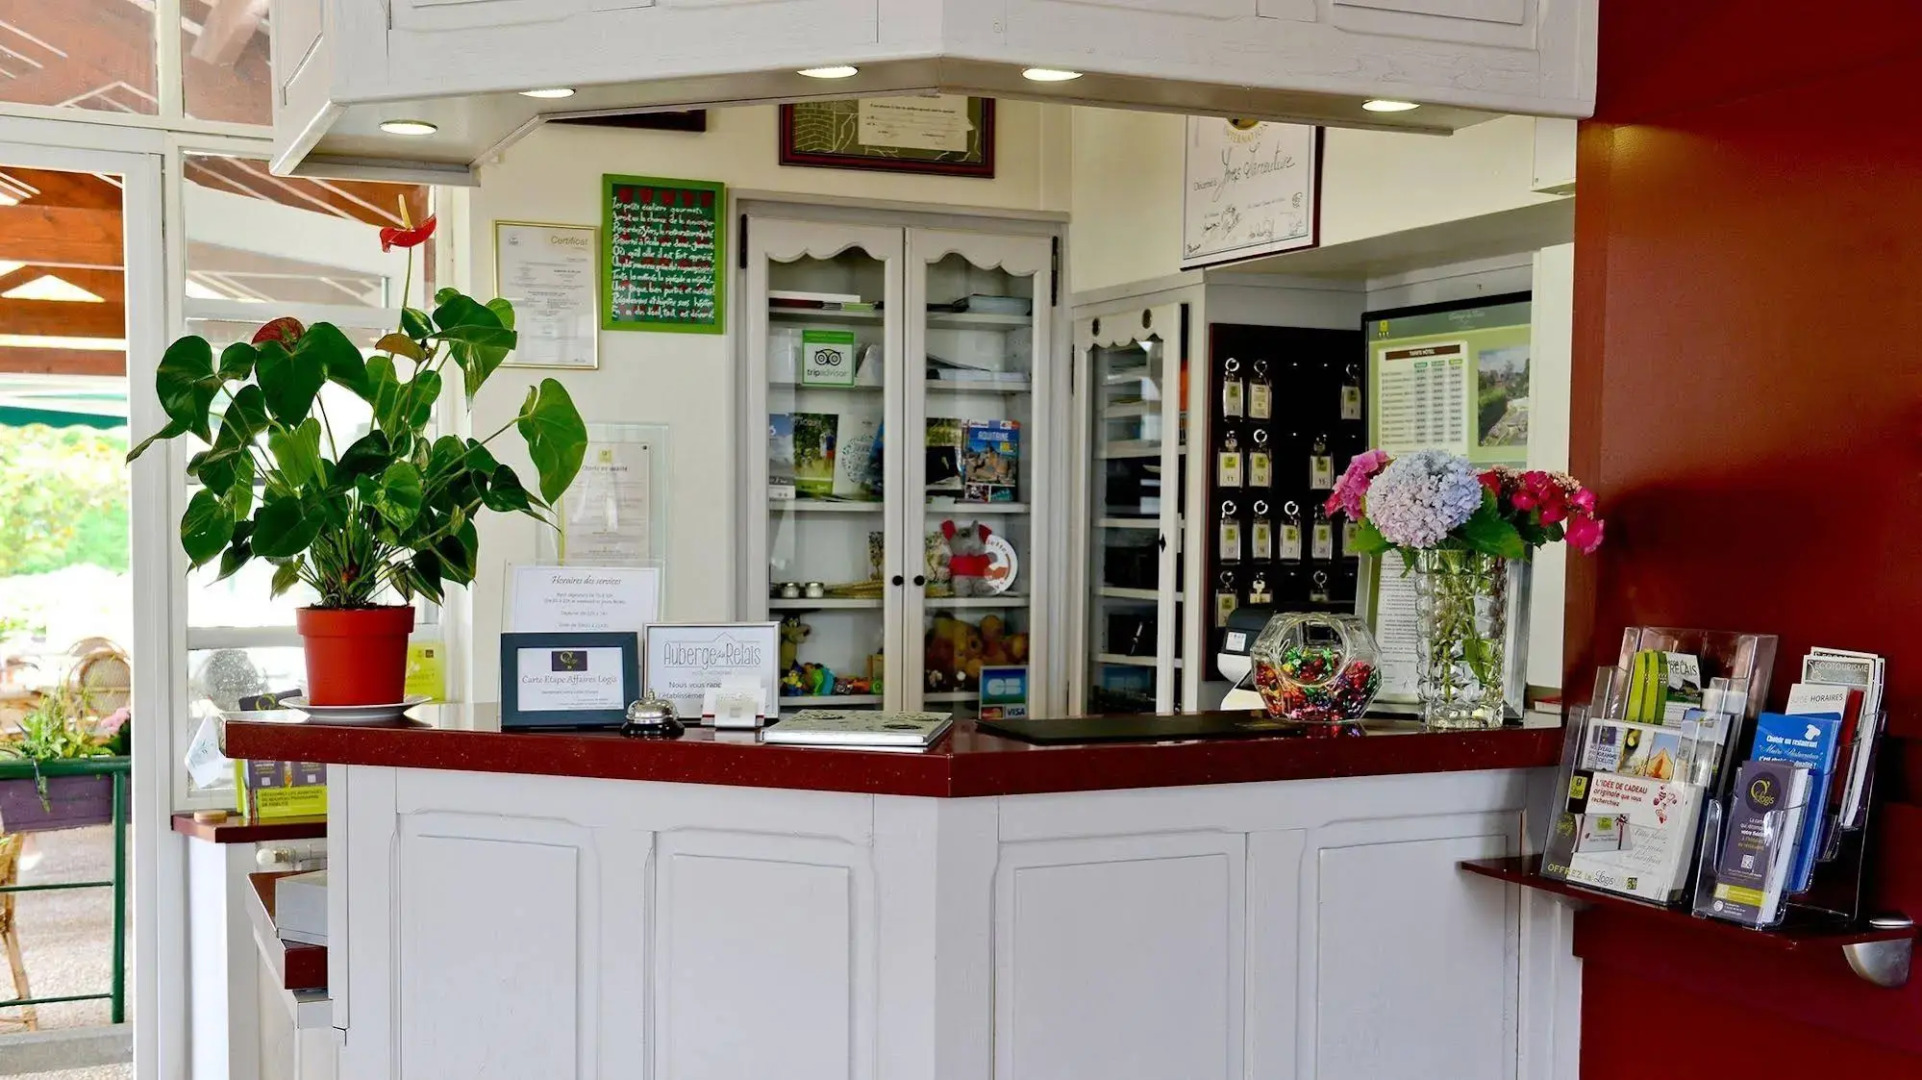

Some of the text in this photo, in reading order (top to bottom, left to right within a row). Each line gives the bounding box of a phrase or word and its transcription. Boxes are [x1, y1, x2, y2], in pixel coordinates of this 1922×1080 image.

[806, 369, 849, 379] tripadvisor
[551, 575, 622, 586] Horaires des services
[663, 642, 717, 670] Auberge
[726, 642, 761, 666] Relais
[1669, 663, 1698, 677] RELAIS
[1814, 660, 1869, 673] ECOTOURISME
[521, 675, 543, 684] Carte
[566, 675, 596, 687] Affaires
[1810, 692, 1844, 703] HORAIRES
[1007, 707, 1026, 716] VISA
[1593, 788, 1621, 800] originale
[1621, 793, 1631, 801] que
[1615, 782, 1625, 792] DE
[1625, 784, 1648, 795] CADEAU
[1547, 863, 1583, 879] OFFREZ
